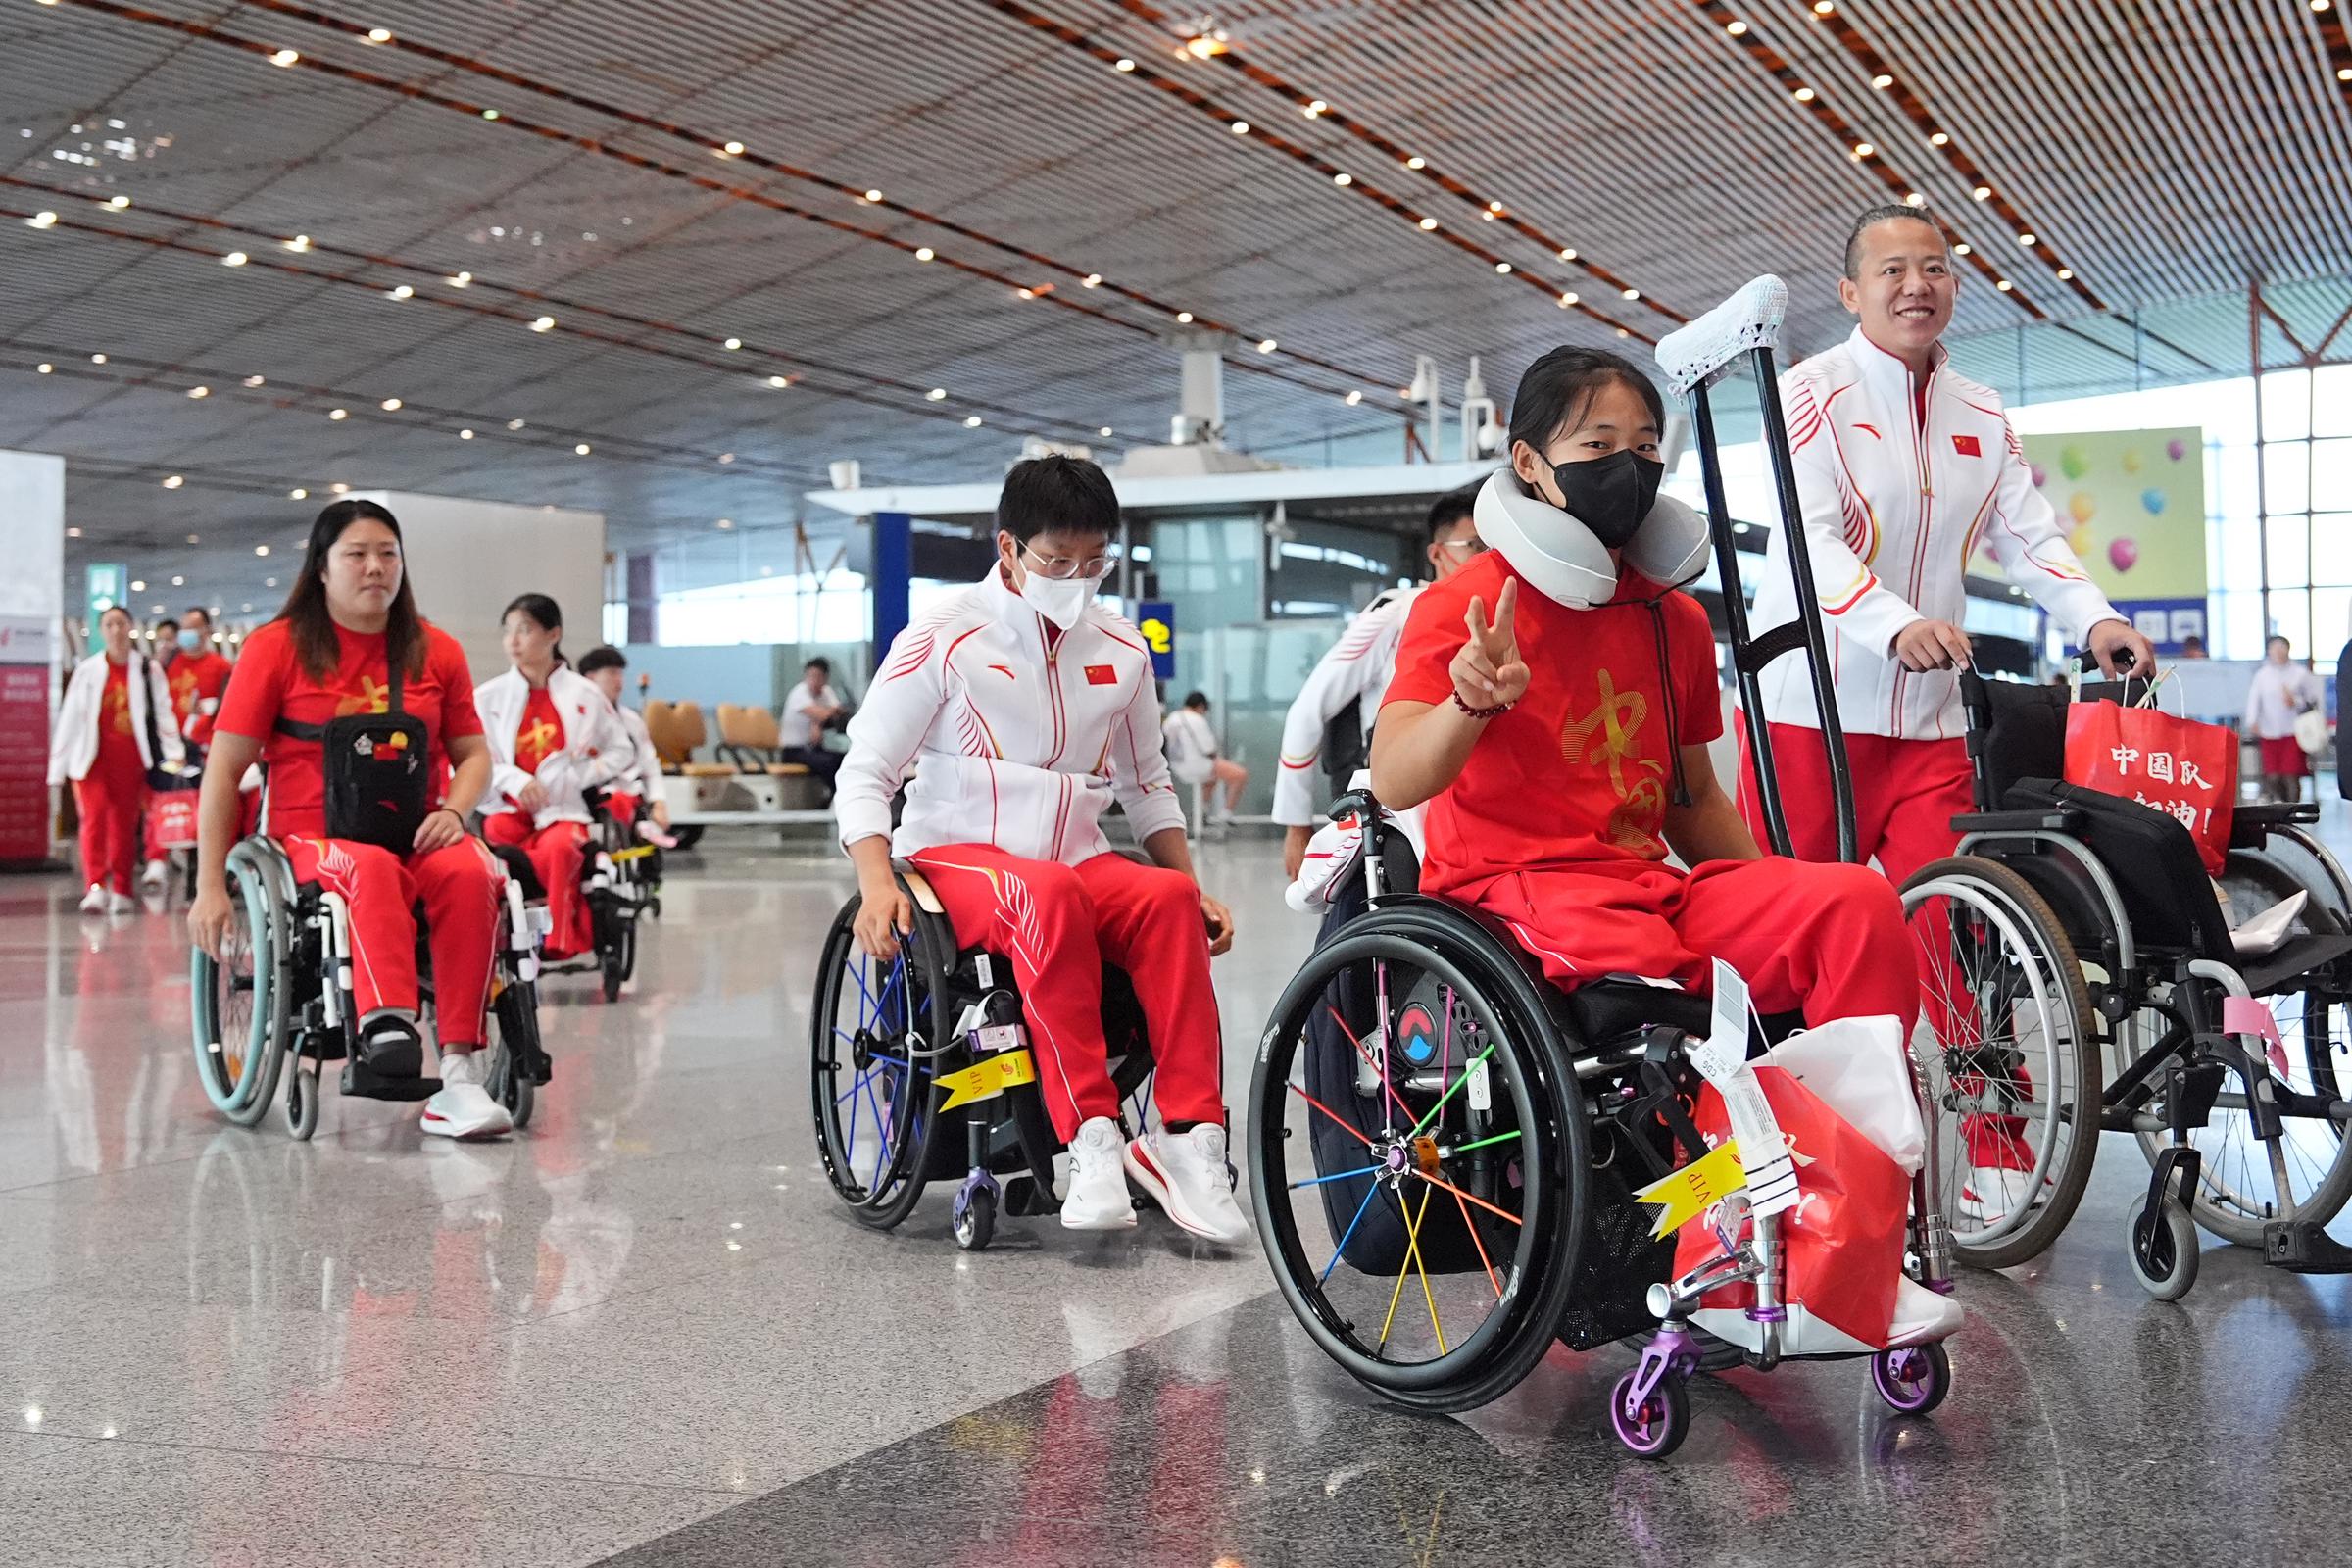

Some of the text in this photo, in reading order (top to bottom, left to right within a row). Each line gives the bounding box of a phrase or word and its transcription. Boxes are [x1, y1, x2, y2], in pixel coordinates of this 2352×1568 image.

[2110, 743, 2214, 790] 中国队
[969, 1071, 983, 1095] VIP
[1688, 1171, 1713, 1204] VIP
